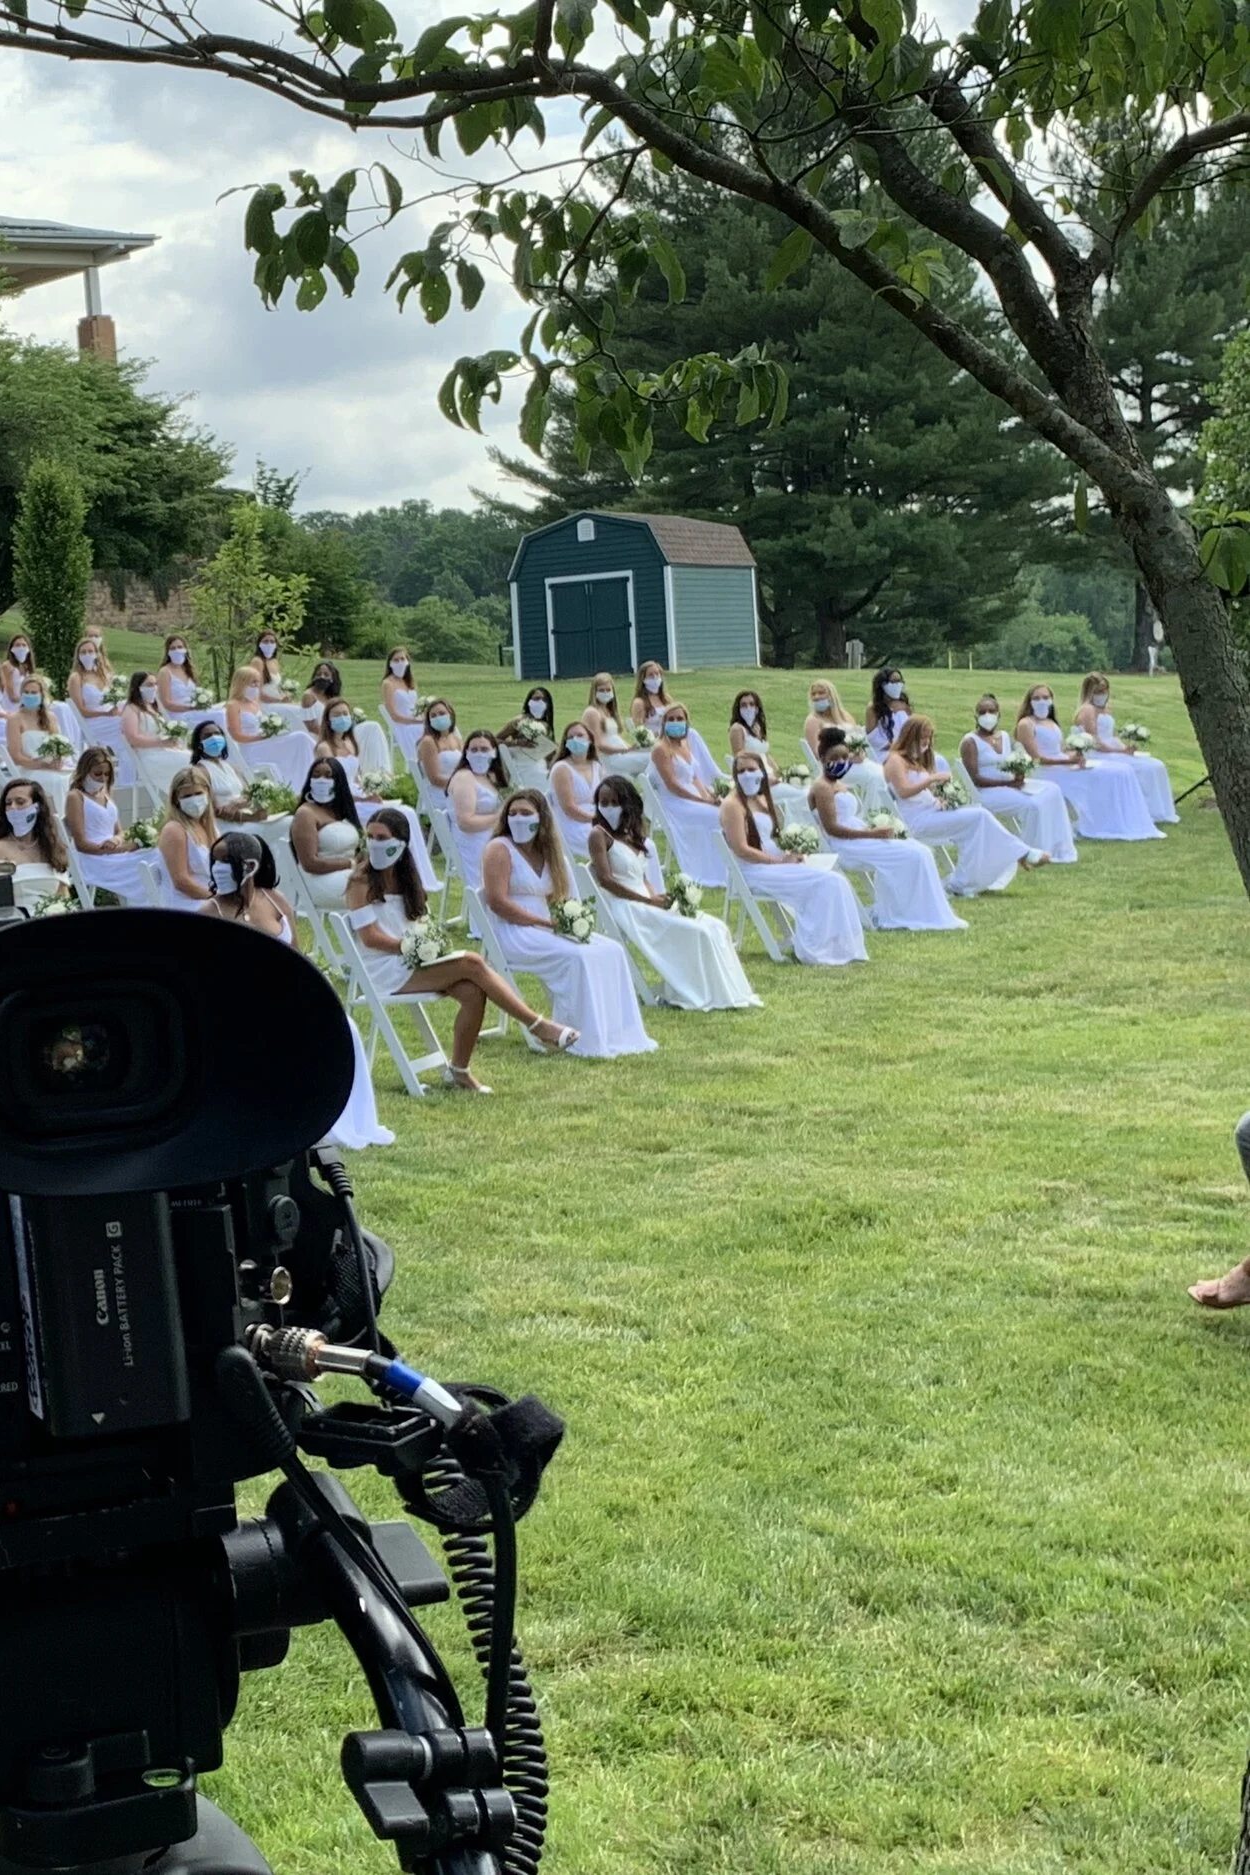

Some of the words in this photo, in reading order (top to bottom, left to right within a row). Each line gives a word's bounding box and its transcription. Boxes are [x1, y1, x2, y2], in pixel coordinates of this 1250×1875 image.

[110, 1243, 125, 1276] PACK
[93, 1268, 110, 1326] Canon
[114, 1277, 131, 1332] BATTERY
